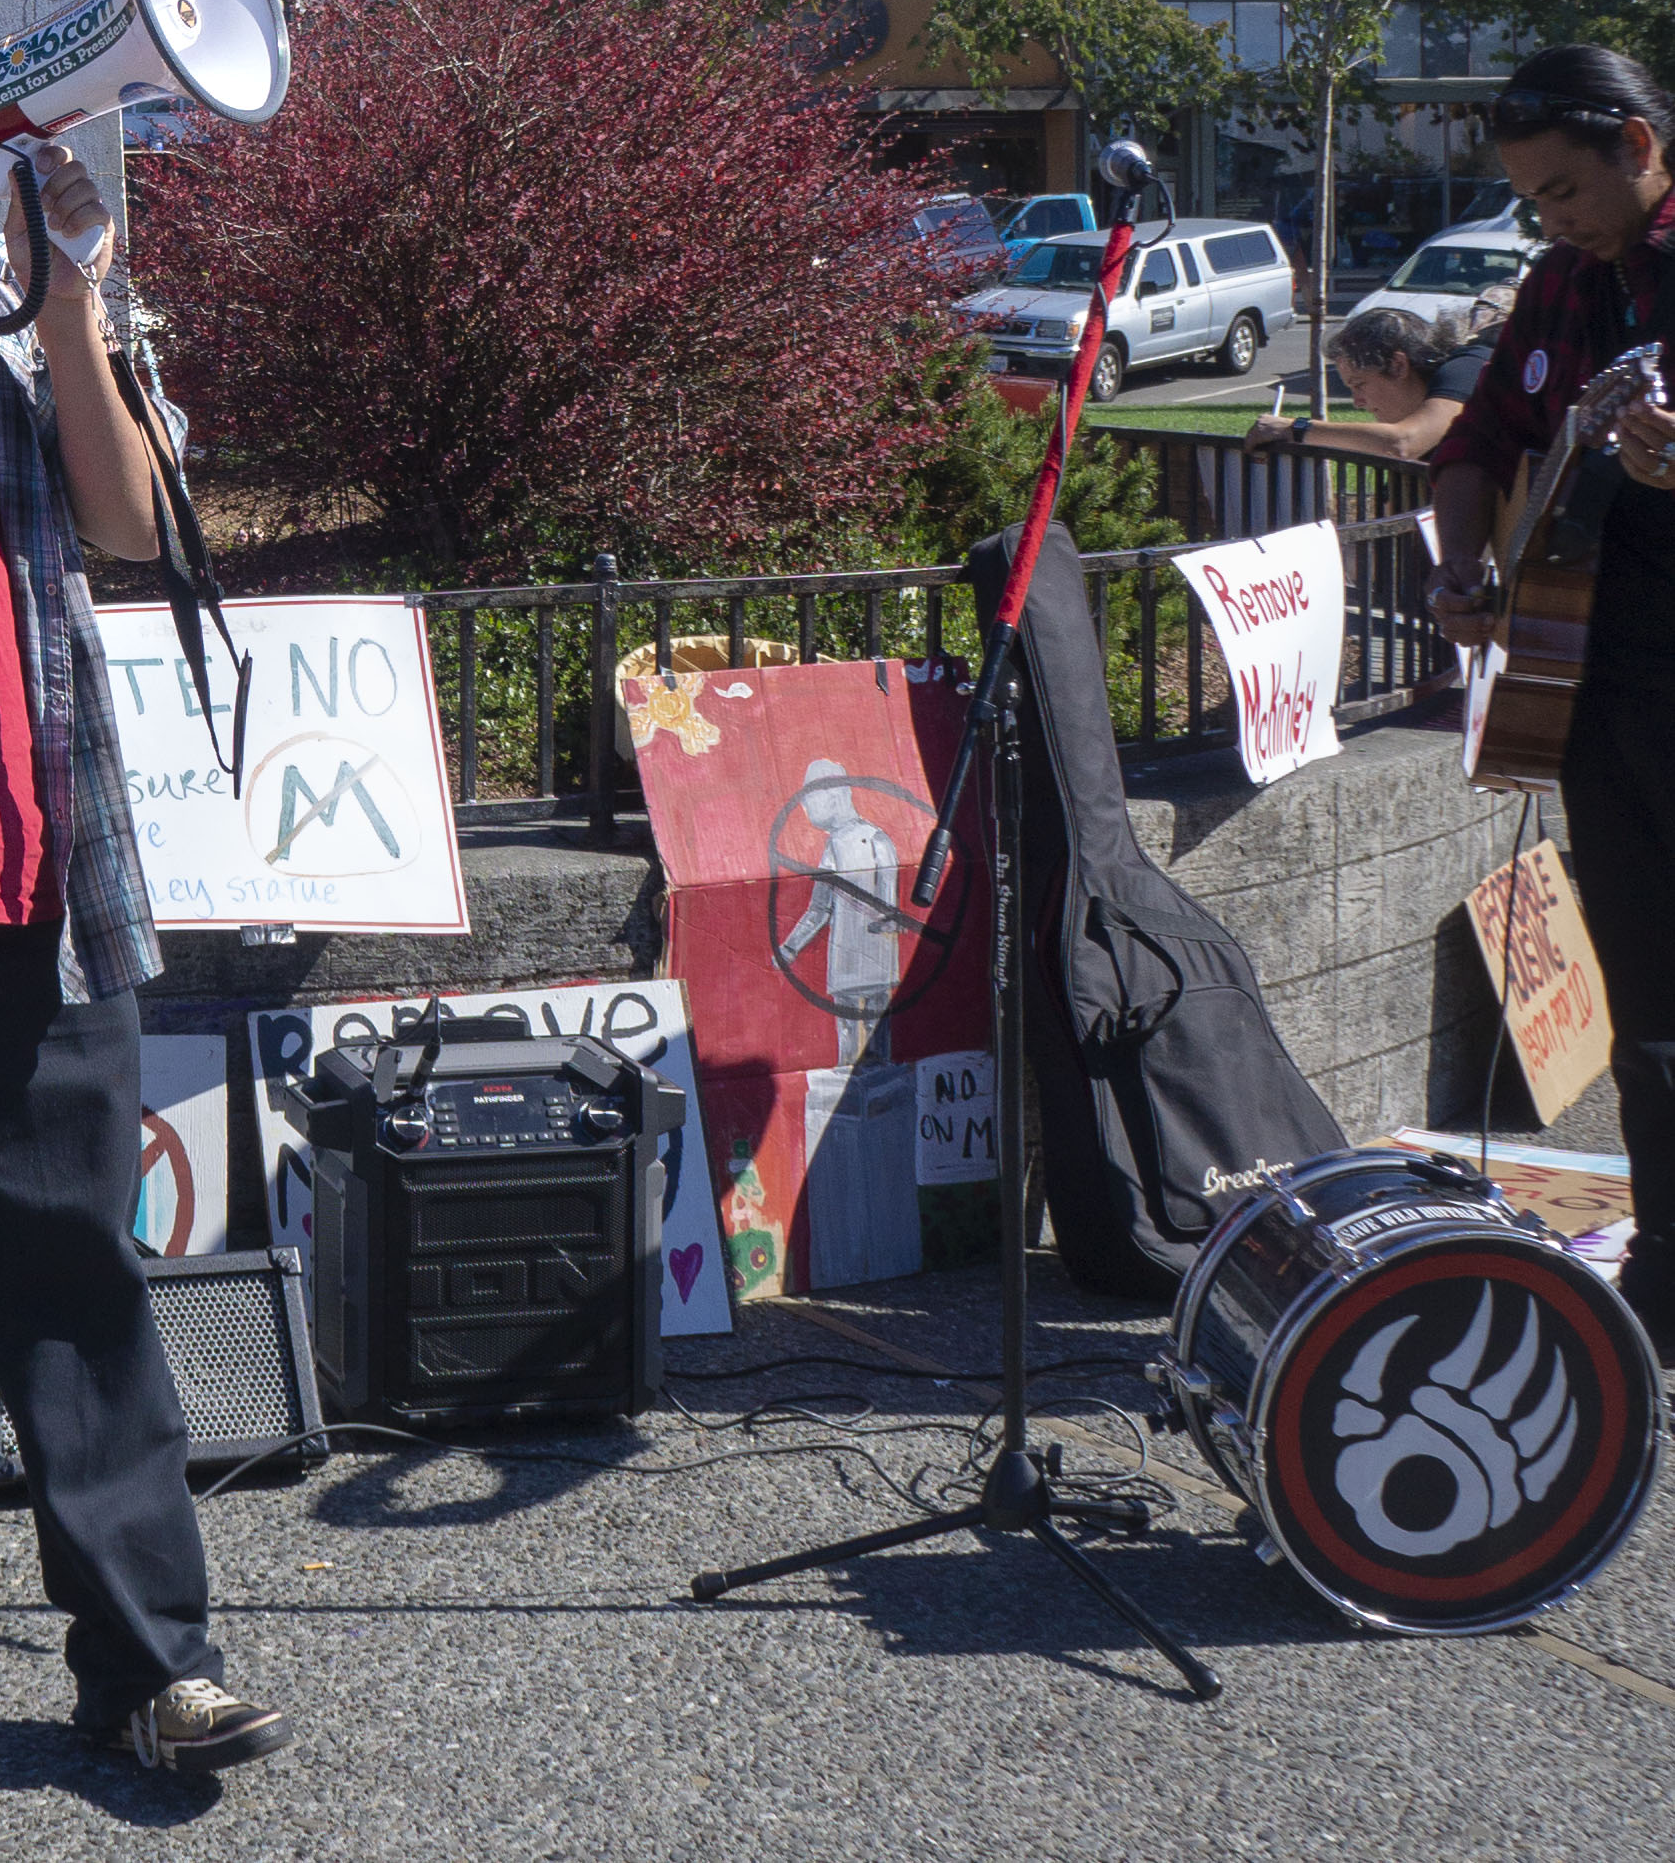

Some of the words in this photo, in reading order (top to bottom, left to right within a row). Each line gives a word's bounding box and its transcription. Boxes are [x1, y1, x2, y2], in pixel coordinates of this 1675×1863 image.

[24, 72, 50, 95] for
[50, 55, 77, 80] U.S.
[76, 11, 130, 64] President
[1202, 564, 1309, 636] Remove
[289, 636, 398, 718] NO
[934, 1068, 977, 1105] NO
[920, 1113, 954, 1146] ON
[961, 1116, 996, 1159] M
[1340, 1216, 1382, 1243] SAVE
[1374, 1205, 1423, 1228] WILD
